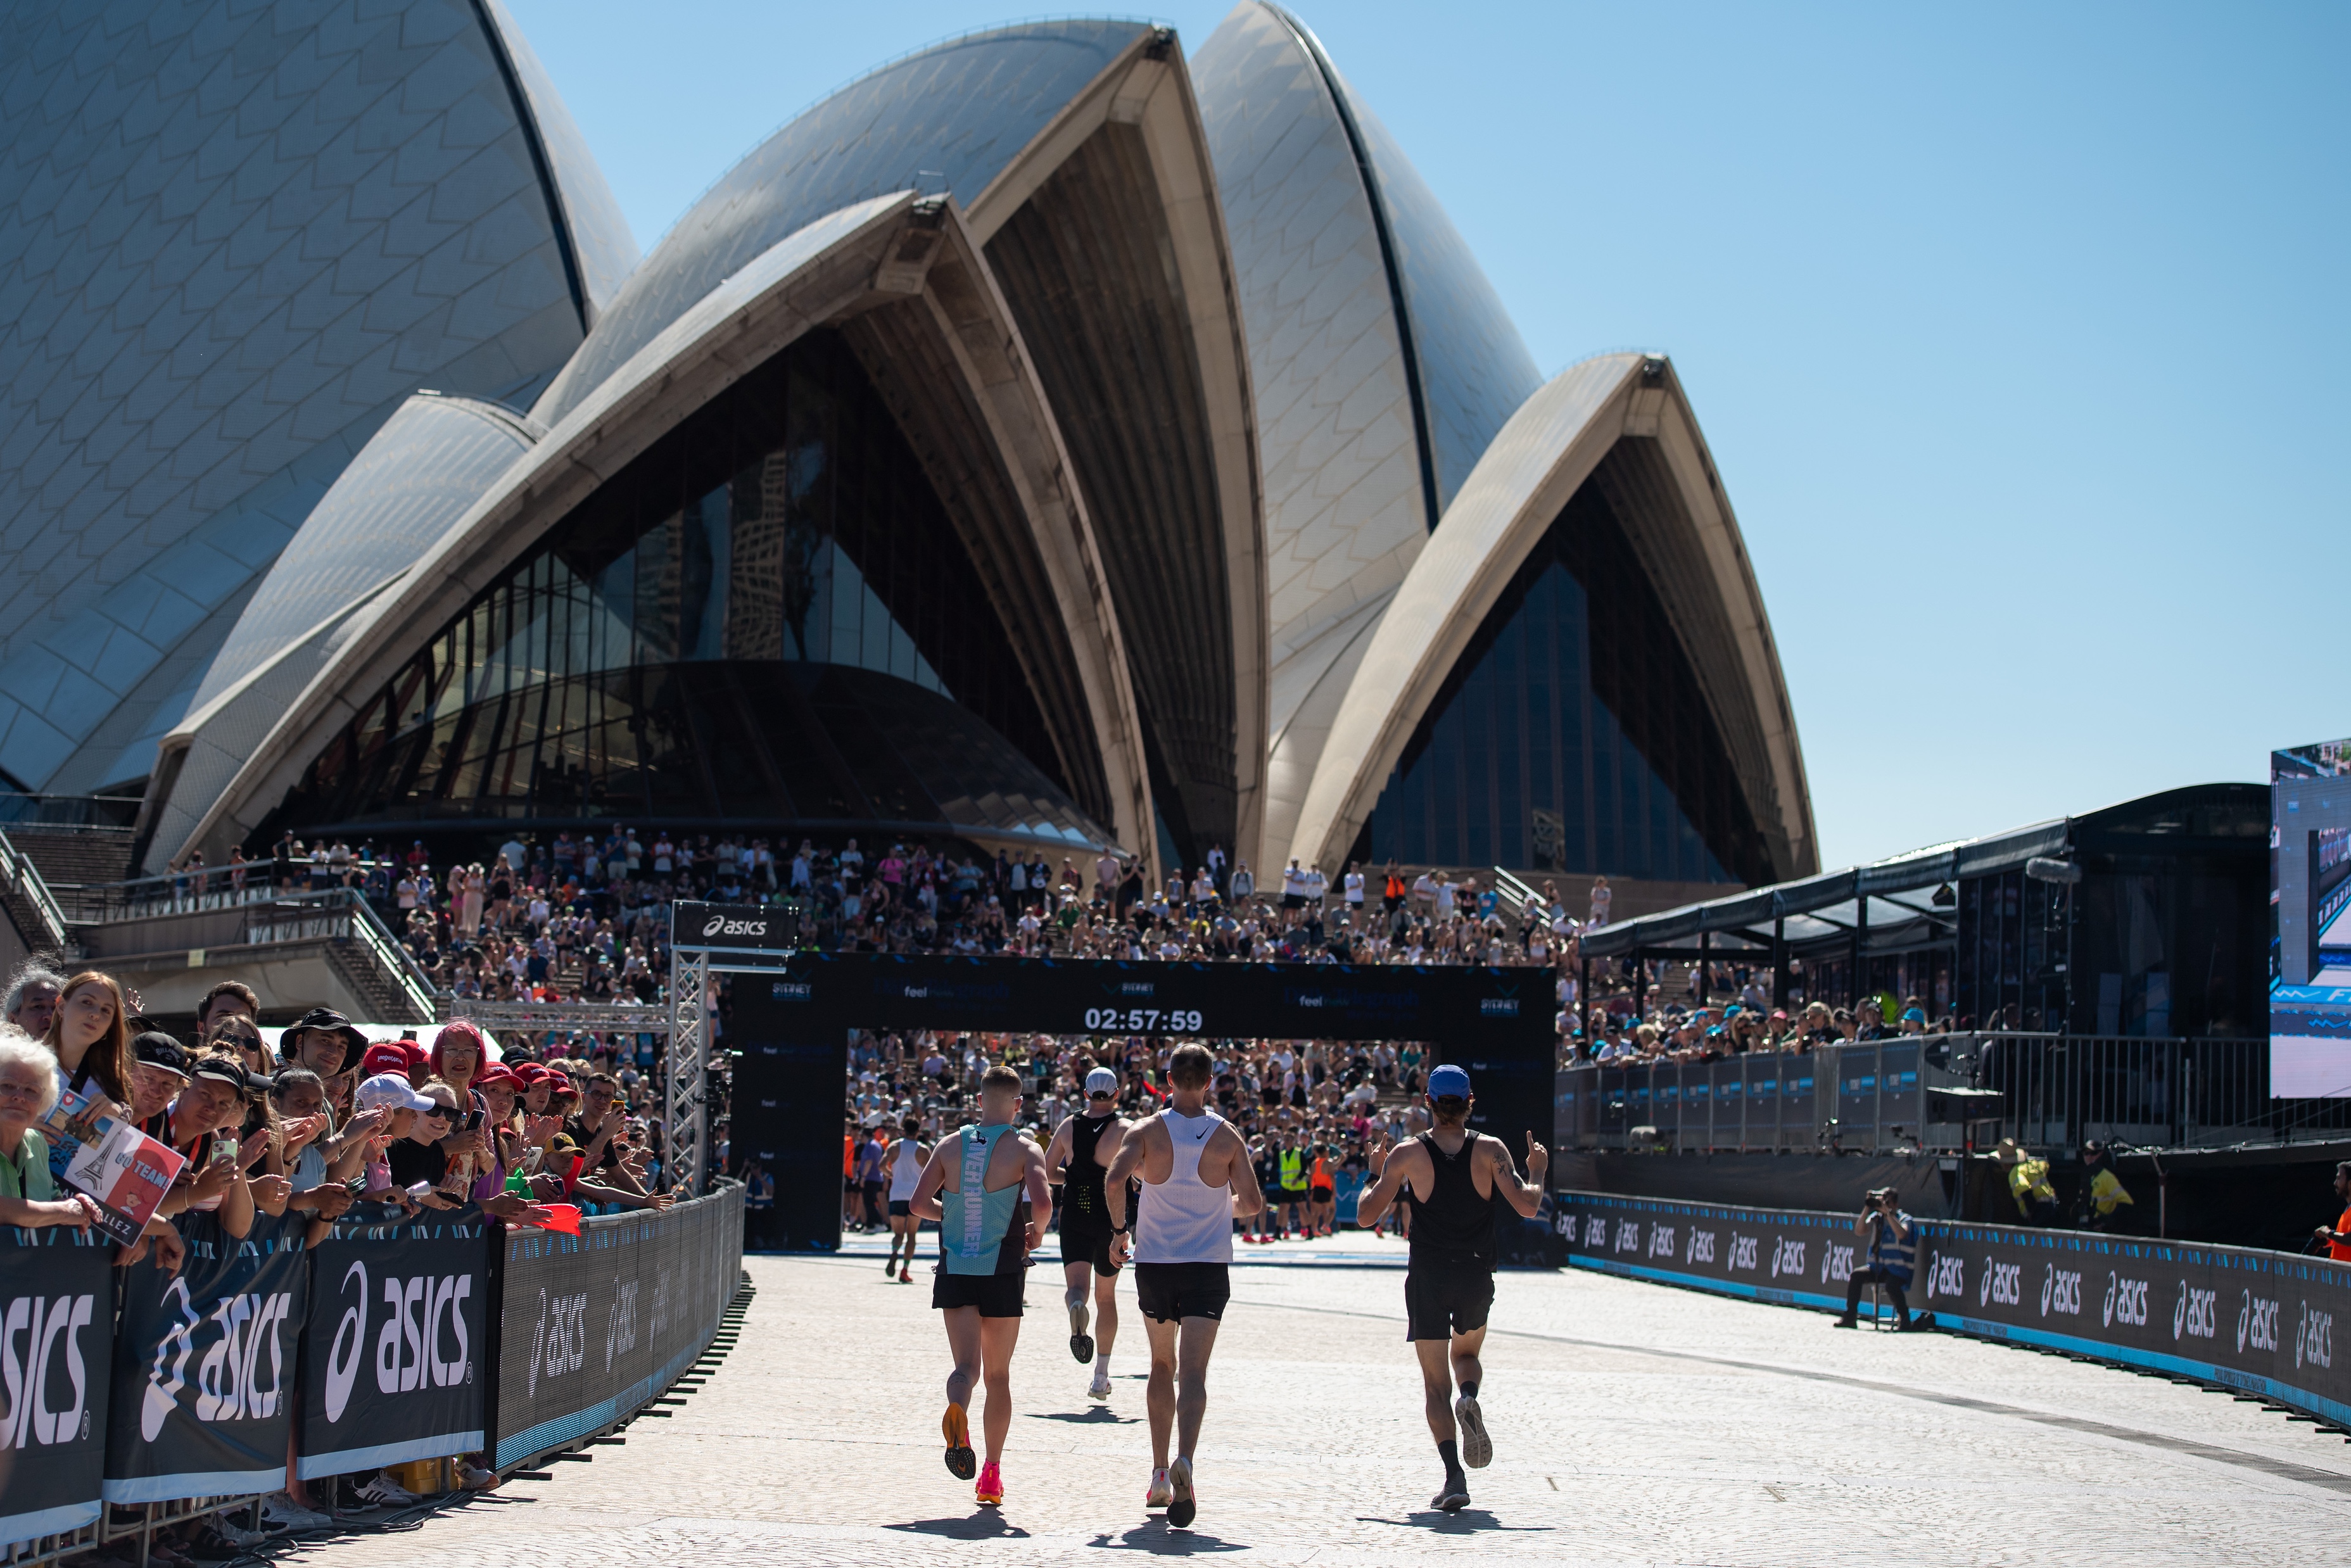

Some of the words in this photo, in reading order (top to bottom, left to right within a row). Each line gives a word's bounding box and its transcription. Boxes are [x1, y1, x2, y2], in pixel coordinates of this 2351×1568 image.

[1084, 1008, 1203, 1032] 02:57:59
[115, 1152, 134, 1168] GO
[132, 1160, 170, 1190] TEAM!
[101, 1211, 132, 1235] LLEZ
[0, 1294, 94, 1451] sics
